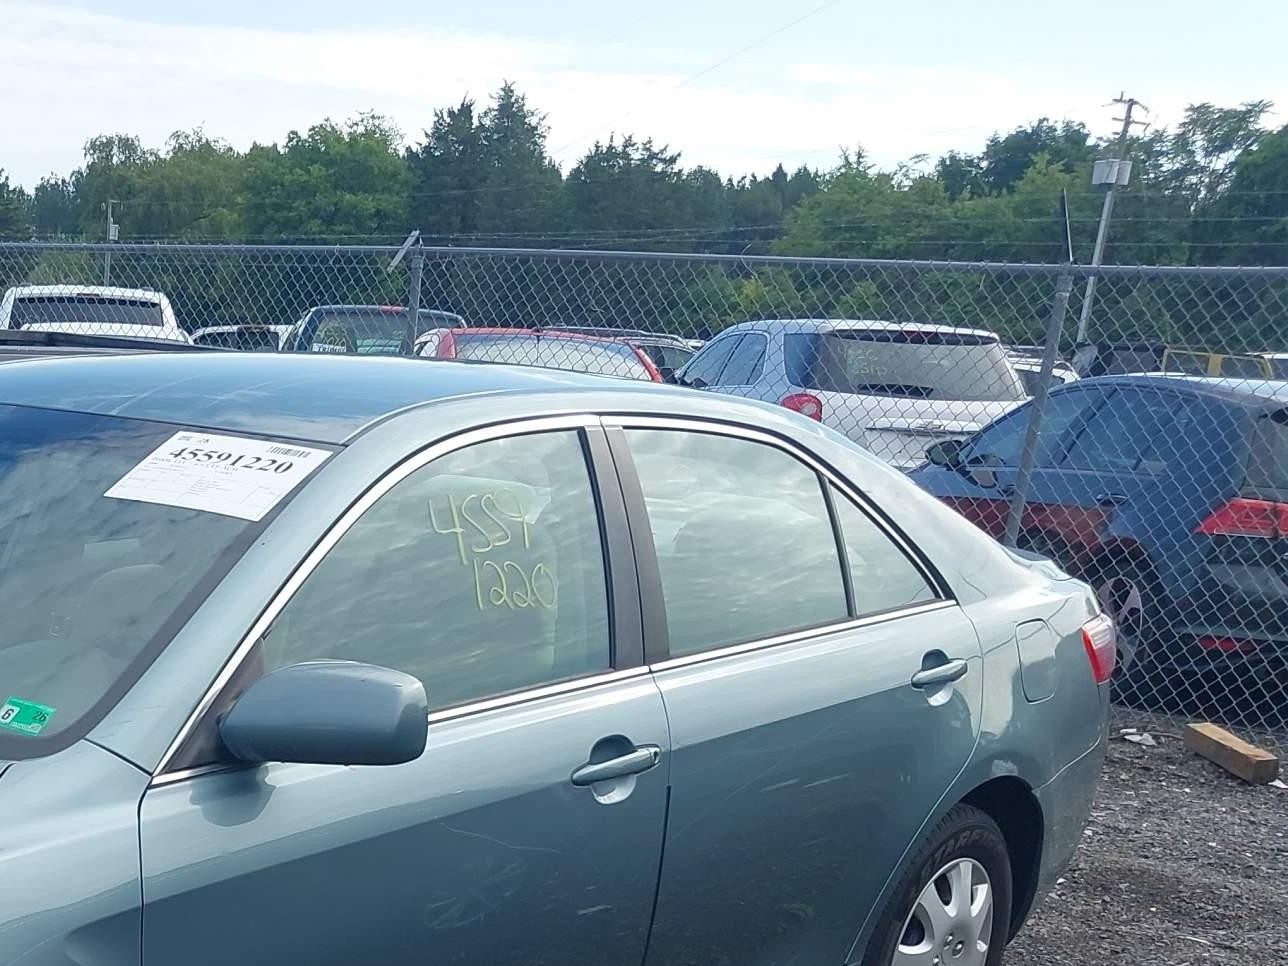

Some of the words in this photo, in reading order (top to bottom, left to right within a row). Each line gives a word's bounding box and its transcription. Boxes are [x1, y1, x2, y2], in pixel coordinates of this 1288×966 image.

[168, 447, 294, 475] 45591220
[428, 487, 531, 566] 4559
[472, 557, 559, 611] 1220
[1, 708, 15, 721] 6
